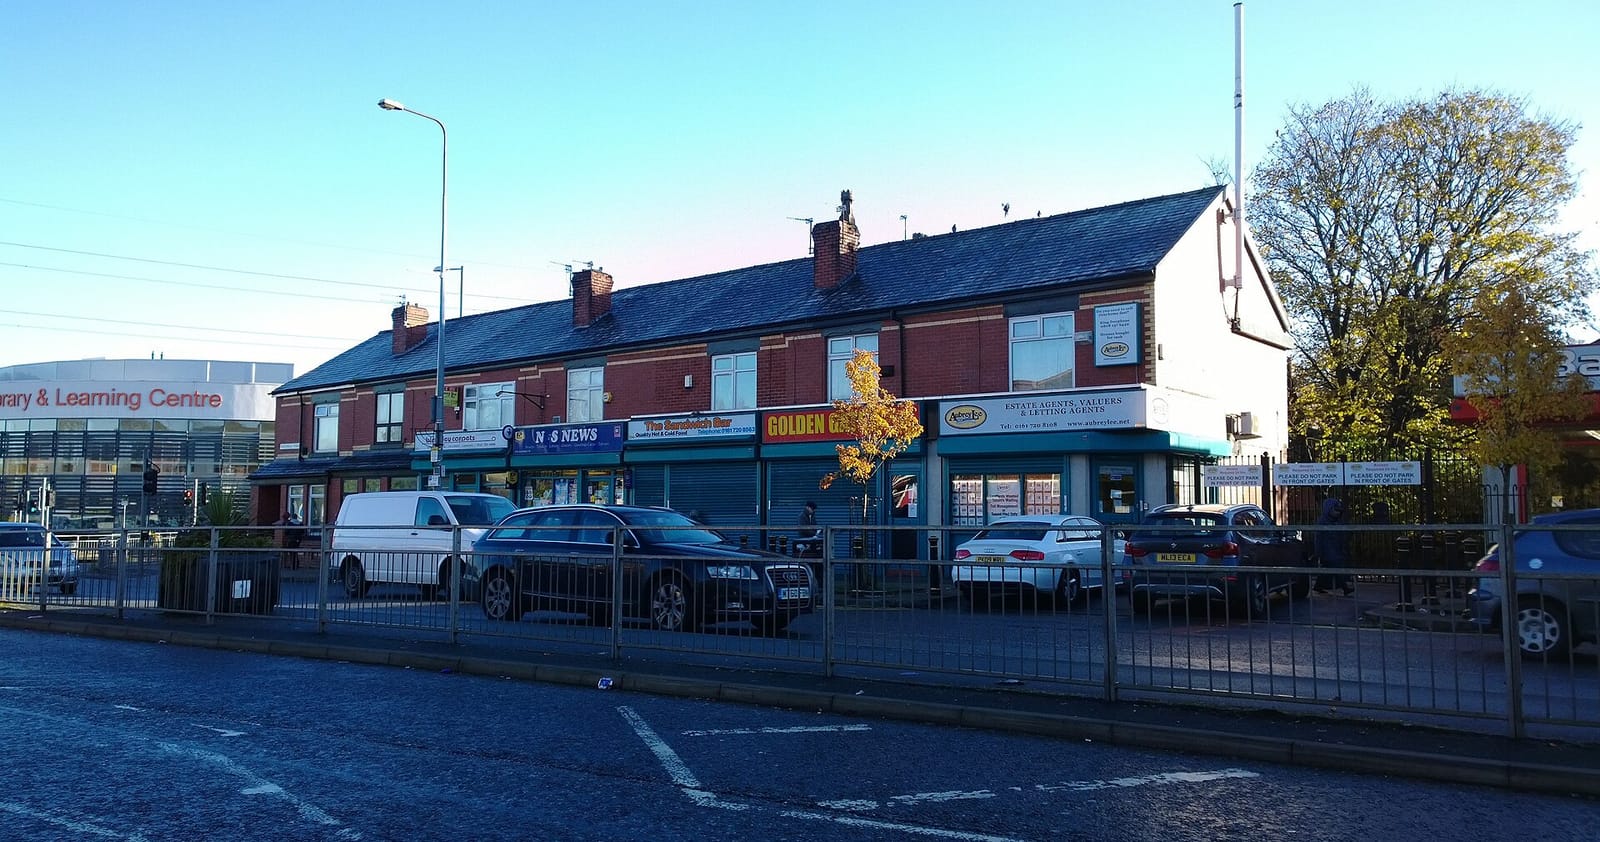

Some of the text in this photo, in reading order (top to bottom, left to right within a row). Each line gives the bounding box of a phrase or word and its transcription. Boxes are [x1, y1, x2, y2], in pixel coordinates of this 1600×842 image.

[37, 388, 49, 406] &
[56, 388, 141, 411] Learning
[149, 388, 222, 408] Centre
[1005, 397, 1122, 410] ESTATE AGENTS, VALUERS
[949, 410, 982, 422] Aubrey Lee
[1029, 408, 1066, 416] LETTING
[1069, 406, 1105, 414] AGENTS
[645, 416, 732, 431] The Sandwich Bar
[768, 413, 825, 436] GOLDEN
[1067, 419, 1130, 427] www.aubreylee.net
[561, 428, 598, 442] NEWS
[1177, 554, 1191, 562] ECA
